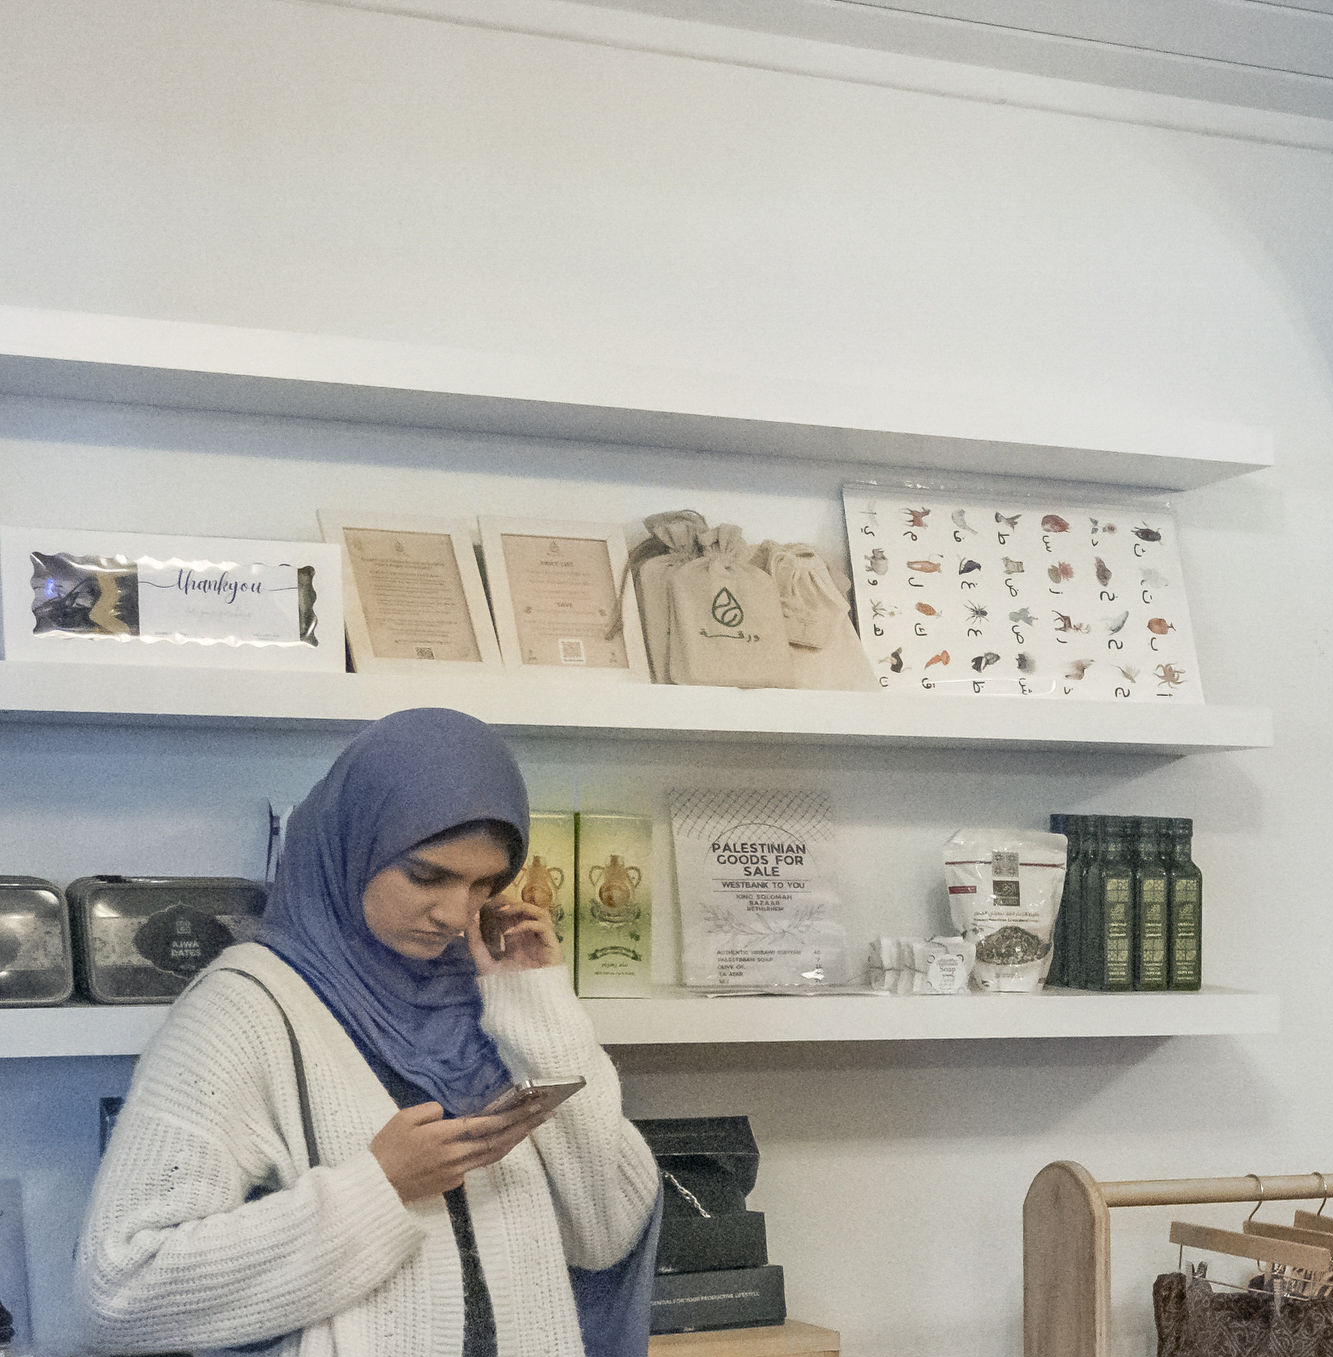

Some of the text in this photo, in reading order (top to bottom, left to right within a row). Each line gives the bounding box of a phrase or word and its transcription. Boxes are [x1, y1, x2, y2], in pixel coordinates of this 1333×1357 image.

[712, 842, 807, 854] PALESTINIAN
[717, 854, 804, 866] GOODS FOR
[743, 866, 780, 877] SALE
[722, 881, 769, 889] WESTBANK
